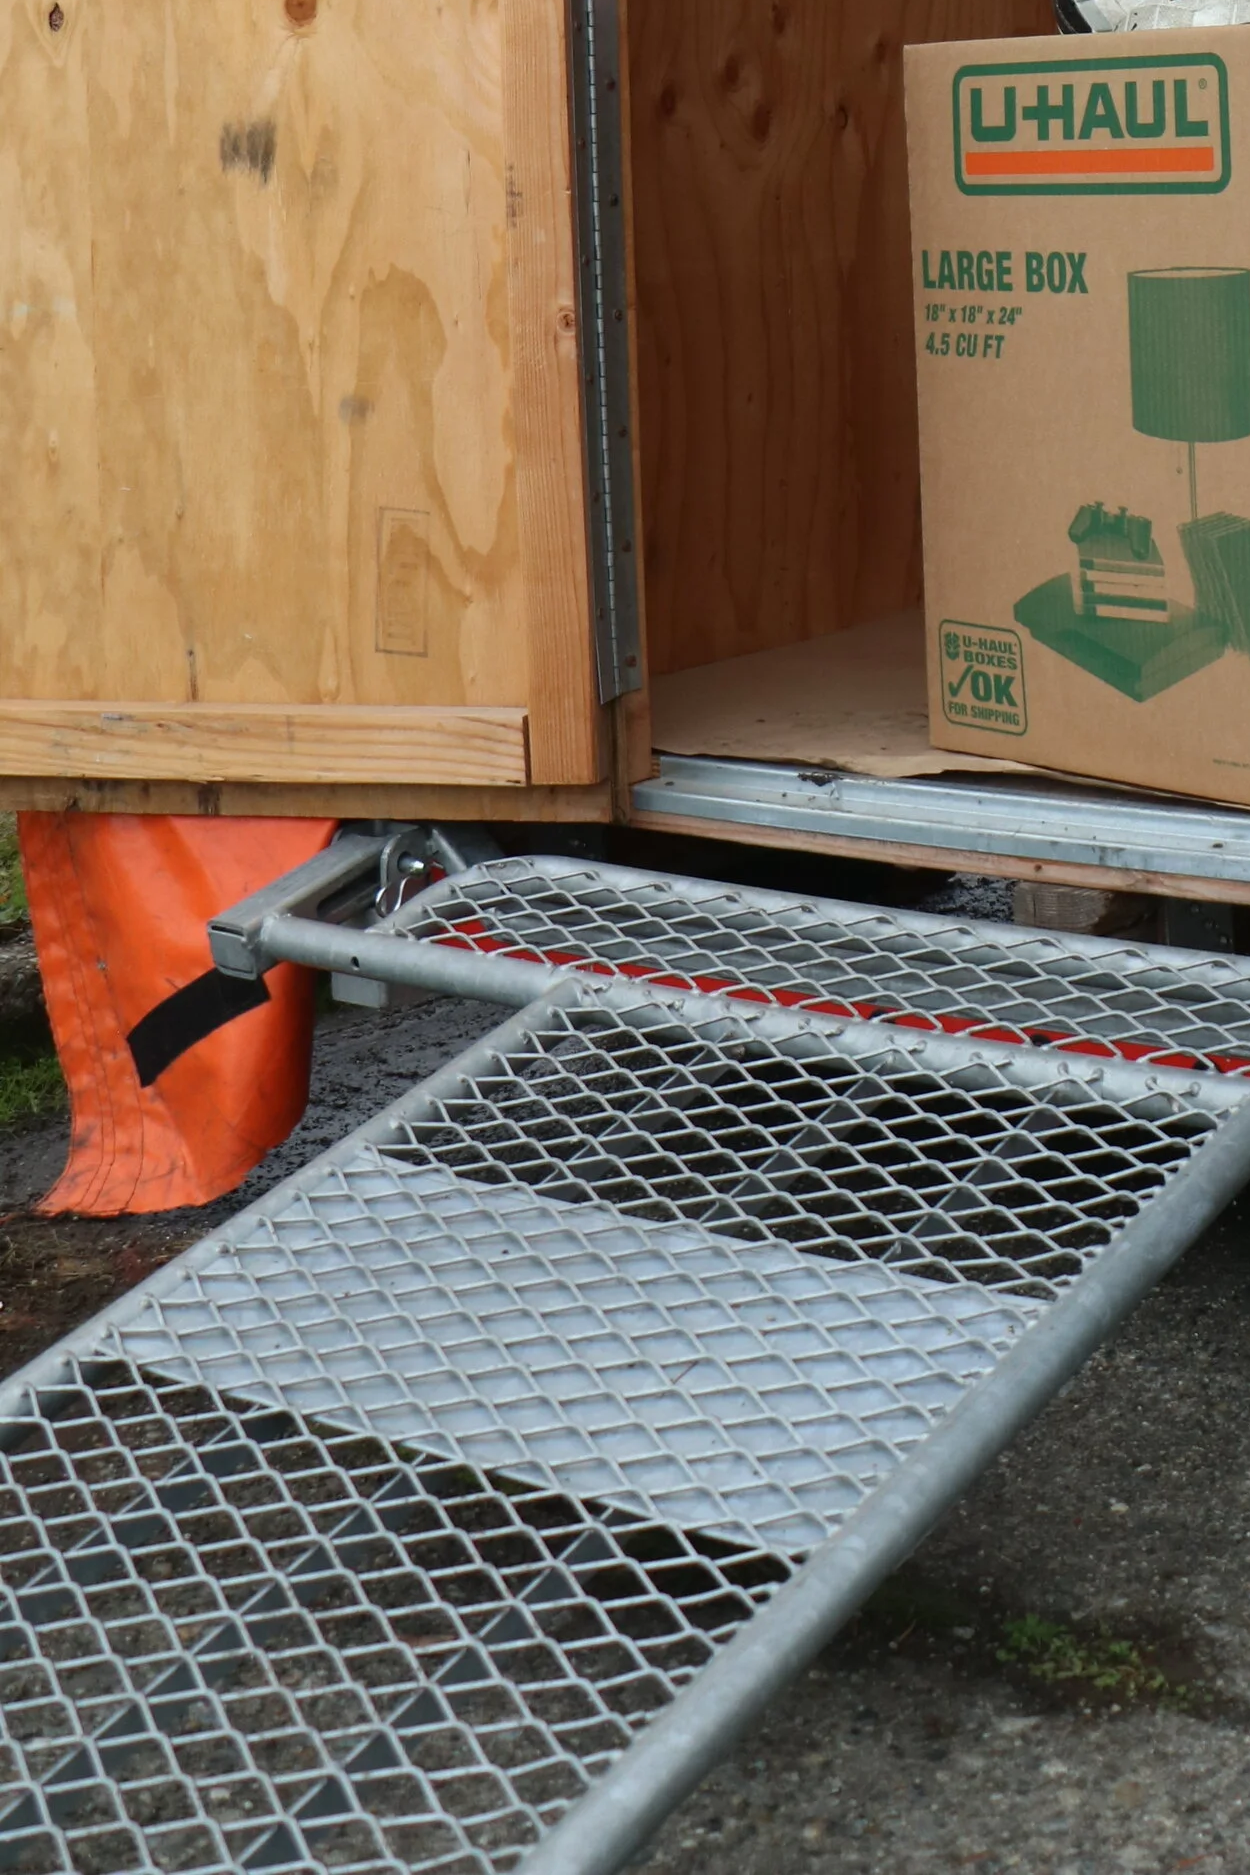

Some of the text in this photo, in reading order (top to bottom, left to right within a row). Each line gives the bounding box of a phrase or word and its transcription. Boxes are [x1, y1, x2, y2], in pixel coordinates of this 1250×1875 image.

[970, 79, 1209, 143] U-HAUL
[921, 249, 1089, 294] LARGE BOX
[924, 303, 1022, 325] 18" x 18" x 24"
[925, 332, 1005, 359] 4.5 CU FT
[962, 635, 1017, 656] U-HAUL
[963, 650, 1018, 670] BOXES
[970, 669, 1018, 708] OK
[948, 700, 1020, 726] FOR SHIPPING
